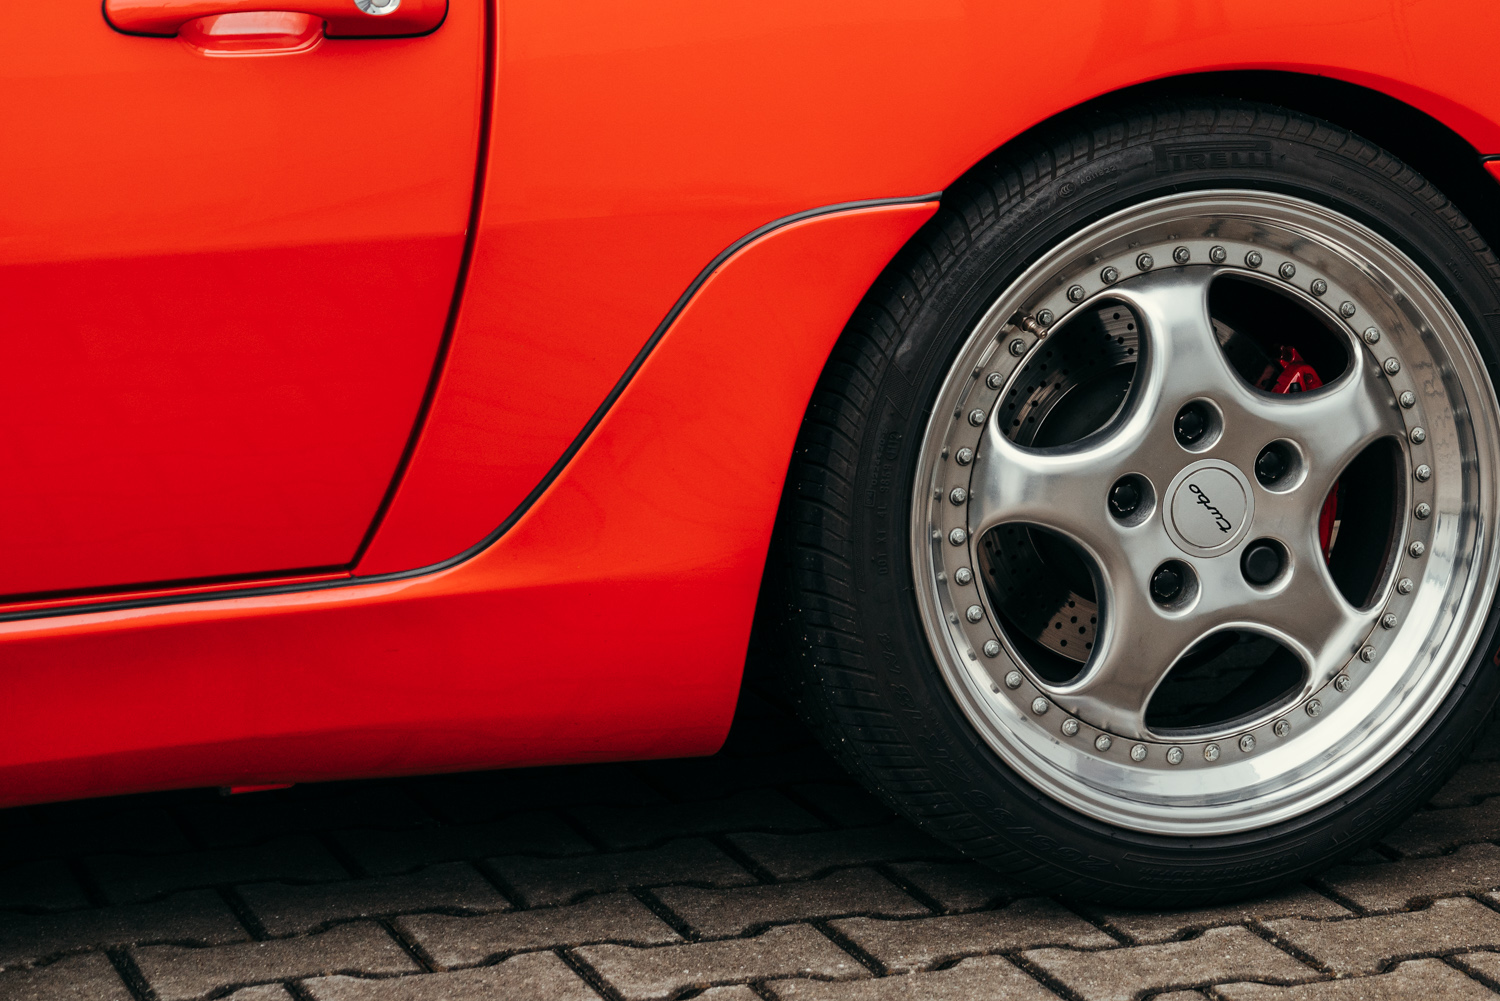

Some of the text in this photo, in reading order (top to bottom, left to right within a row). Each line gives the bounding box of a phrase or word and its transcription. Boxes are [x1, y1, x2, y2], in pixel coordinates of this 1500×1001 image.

[1153, 140, 1273, 173] PIRELLI
[1188, 483, 1232, 534] turbo
[877, 551, 889, 575] DOT
[964, 788, 1112, 872] 265/35
